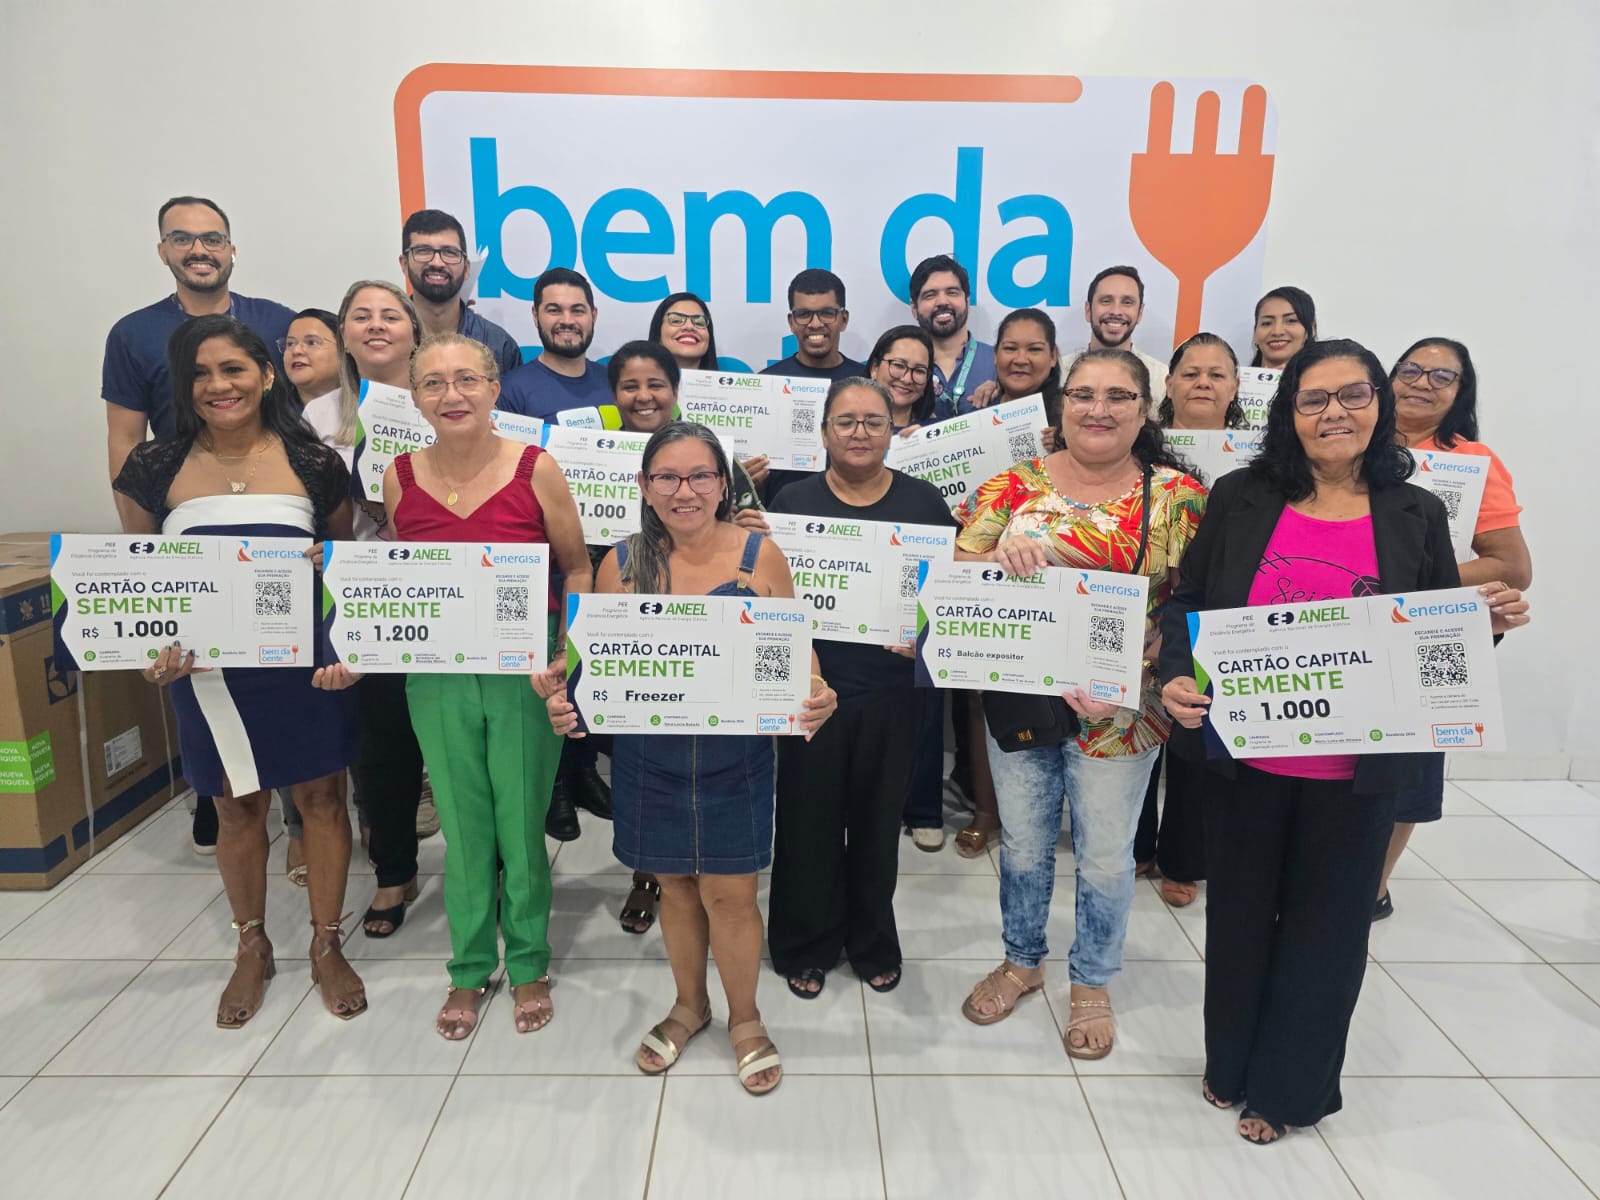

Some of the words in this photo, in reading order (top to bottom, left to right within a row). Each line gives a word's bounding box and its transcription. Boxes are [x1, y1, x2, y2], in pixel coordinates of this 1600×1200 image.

[469, 137, 833, 304] bem
[881, 147, 1074, 308] da
[734, 377, 762, 387] ANEEL
[791, 385, 825, 393] energisa
[686, 401, 727, 413] CARTÃO
[729, 405, 770, 415] CAPITAL
[1000, 405, 1039, 420] energisa
[566, 418, 585, 427] Bem
[686, 413, 753, 428] SEMENTE
[942, 420, 970, 435] ANEEL
[373, 424, 421, 443] CARTÃO
[499, 422, 537, 435] energisa
[616, 441, 646, 451] ANEE
[900, 457, 940, 474] CARTÃO
[943, 446, 985, 463] CAPITAL
[372, 463, 384, 474] R$
[562, 468, 606, 481] ARTÃO
[609, 472, 638, 483] CAPI
[914, 461, 972, 482] MENTE
[1433, 462, 1480, 474] energisa
[568, 482, 638, 500] EMENTE
[578, 502, 627, 519] 1.000
[827, 523, 863, 536] ANEEL
[902, 534, 948, 545] energisa
[157, 542, 204, 554] ANEEL
[251, 548, 305, 559] energisa
[412, 549, 452, 560] ANEEL
[493, 554, 541, 564] energisa
[785, 554, 817, 568] TÃO
[818, 559, 872, 573] CAPITAL
[75, 578, 146, 594] CARTÃO
[151, 581, 219, 593] CAPITAL
[793, 573, 849, 590] MENTE
[1005, 573, 1046, 584] ANEEL
[342, 584, 402, 598] CARTÃO
[406, 587, 464, 598] CAPITAL
[1089, 583, 1140, 597] energisa
[76, 597, 192, 615] SEMENTE
[343, 602, 441, 618] SEMENTE
[665, 603, 708, 615] ANEEL
[936, 604, 993, 618] CARTÃO
[997, 608, 1057, 623] CAPITAL
[1408, 602, 1478, 617] energisa
[753, 611, 805, 622] energisa
[1298, 606, 1350, 623] ANEEL
[82, 627, 99, 639] R$
[113, 620, 179, 638] 1.000
[347, 631, 362, 641] R$
[374, 625, 429, 641] 1.200
[935, 620, 1032, 640] SEMENTE
[589, 640, 653, 655] CARTÃO
[657, 643, 721, 656] CAPITAL
[938, 648, 952, 658] R$
[957, 650, 984, 658] Balcão
[986, 652, 1025, 661] expositor
[589, 659, 695, 677] SEMENTE
[1218, 654, 1290, 674] CARTÃO
[1296, 650, 1373, 669] CAPITAL
[1092, 682, 1109, 691] bem
[1109, 684, 1120, 693] da
[1221, 670, 1344, 697] SEMENTE
[593, 689, 608, 703] R$
[625, 690, 685, 702] Freezer
[1229, 709, 1247, 723] R$
[1260, 698, 1331, 721] 1.000
[759, 717, 776, 725] bem
[777, 717, 787, 725] da
[1435, 727, 1459, 736] bem
[1460, 726, 1474, 736] da
[1436, 736, 1465, 745] gente
